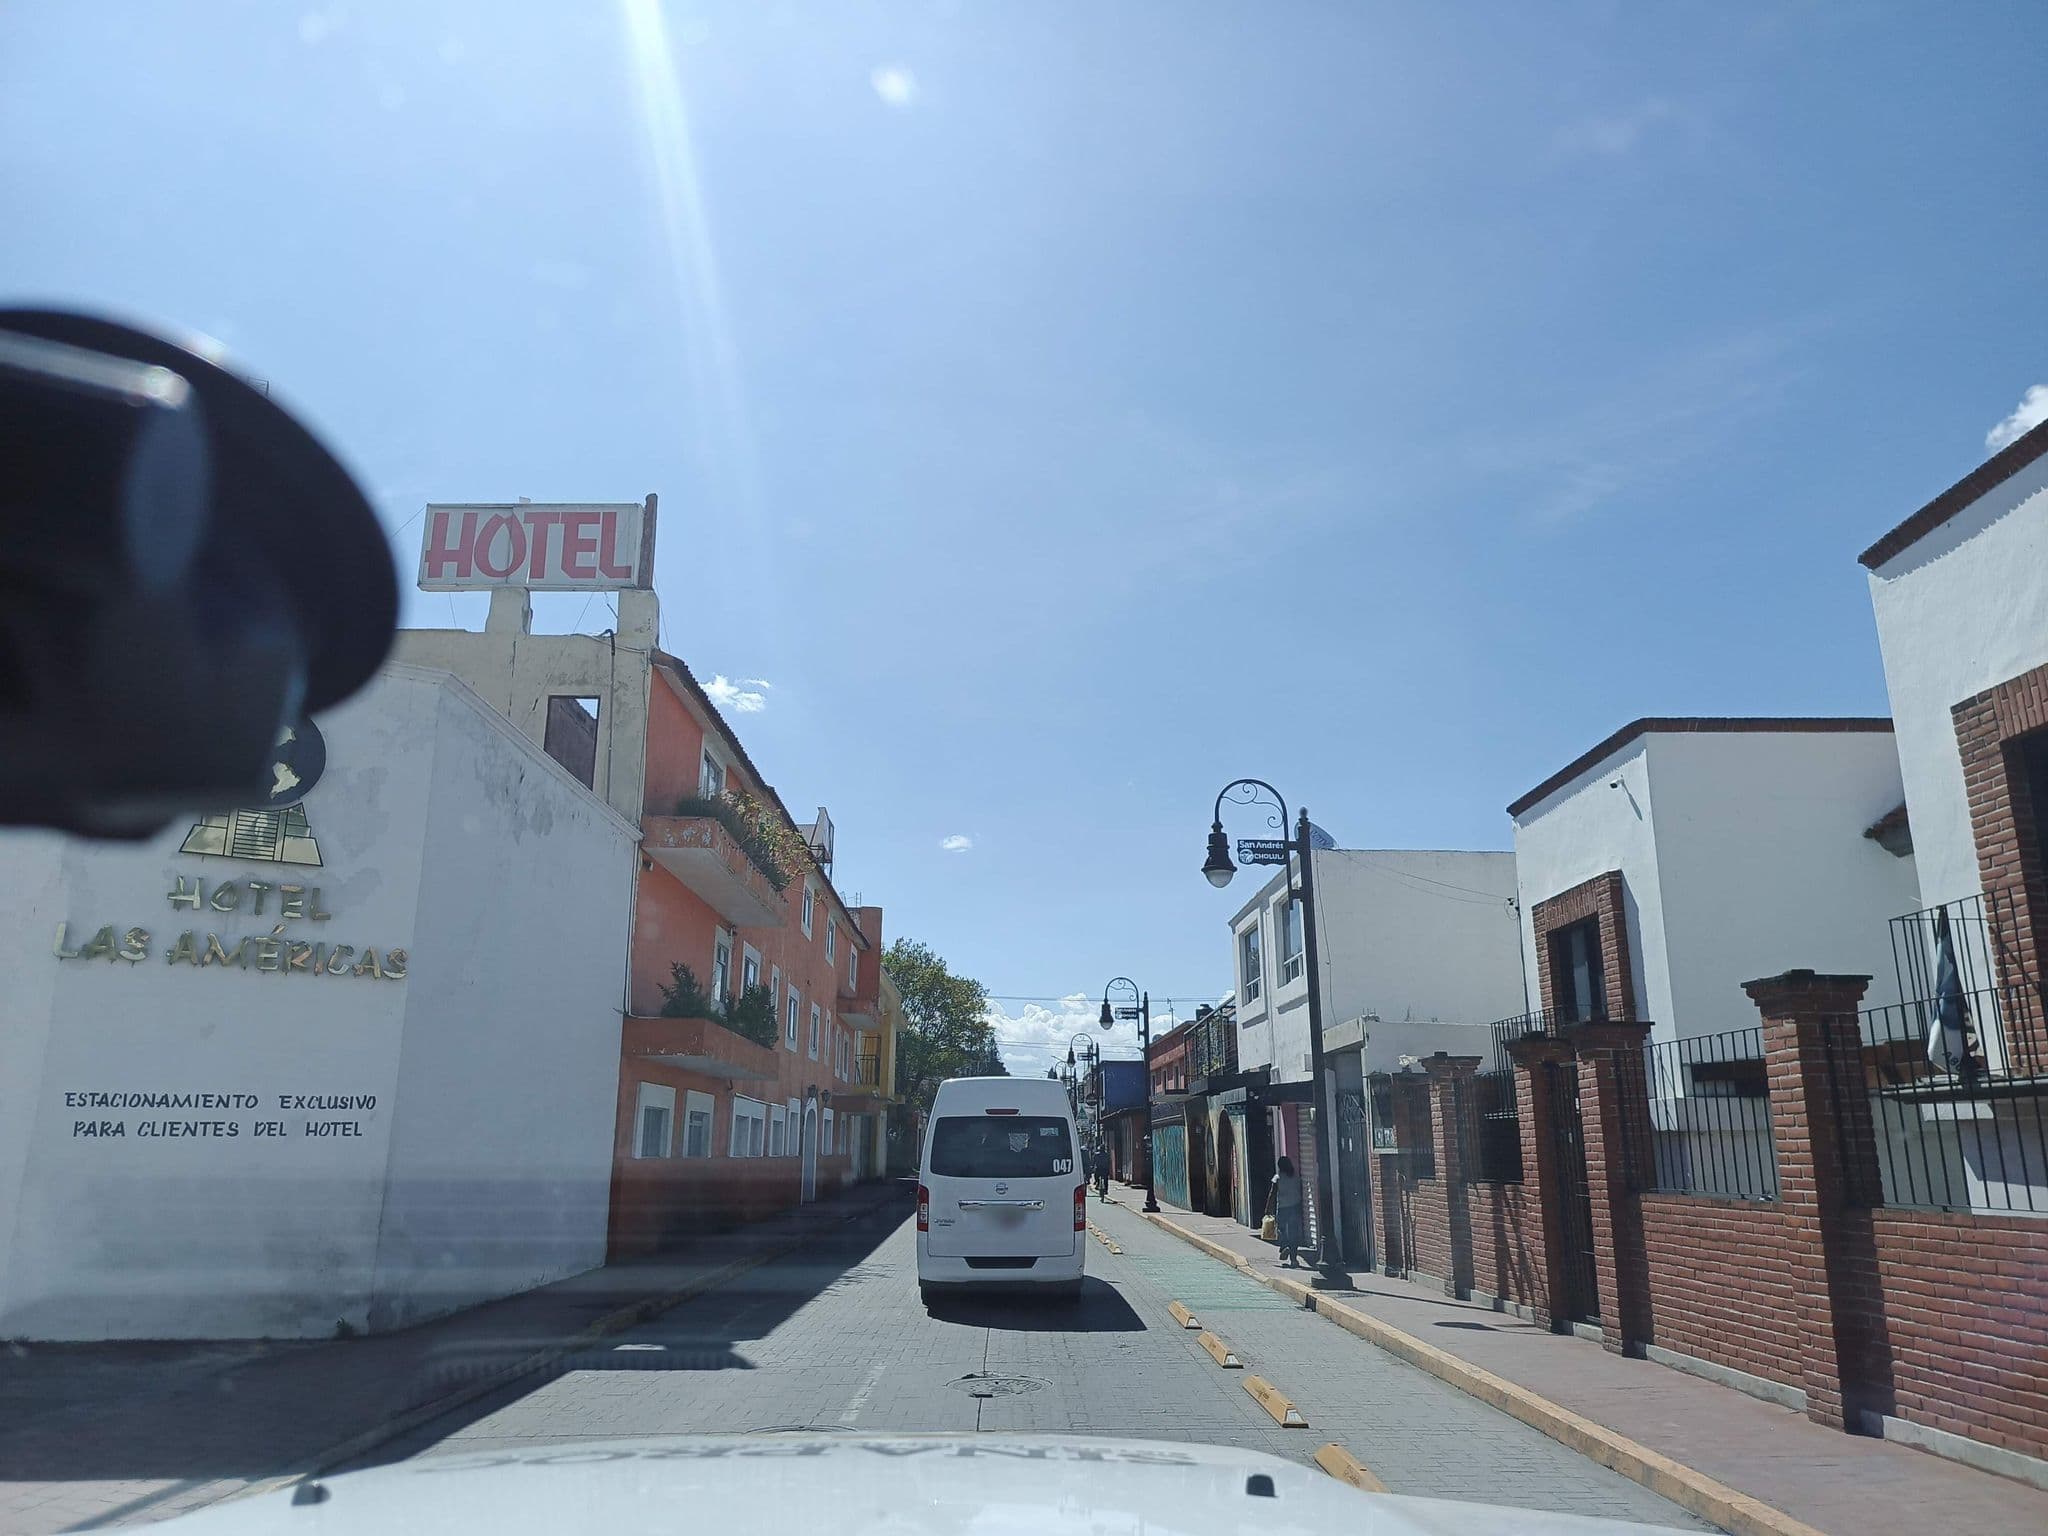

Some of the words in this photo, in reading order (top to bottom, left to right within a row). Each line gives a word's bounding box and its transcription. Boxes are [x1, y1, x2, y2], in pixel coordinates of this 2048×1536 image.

[424, 511, 632, 579] HOTEL
[167, 876, 331, 921] HOTEL
[52, 922, 150, 968] LAS
[165, 923, 408, 979] AMÉRICAS
[65, 1092, 259, 1110] ESTACIONAMIENTO
[279, 1094, 377, 1111] EXCLUSIVO
[73, 1120, 126, 1138] PARA
[137, 1120, 240, 1138] CLIENTES
[254, 1121, 288, 1138] DEL
[305, 1121, 363, 1138] HOTEL
[1053, 1158, 1072, 1173] 047
